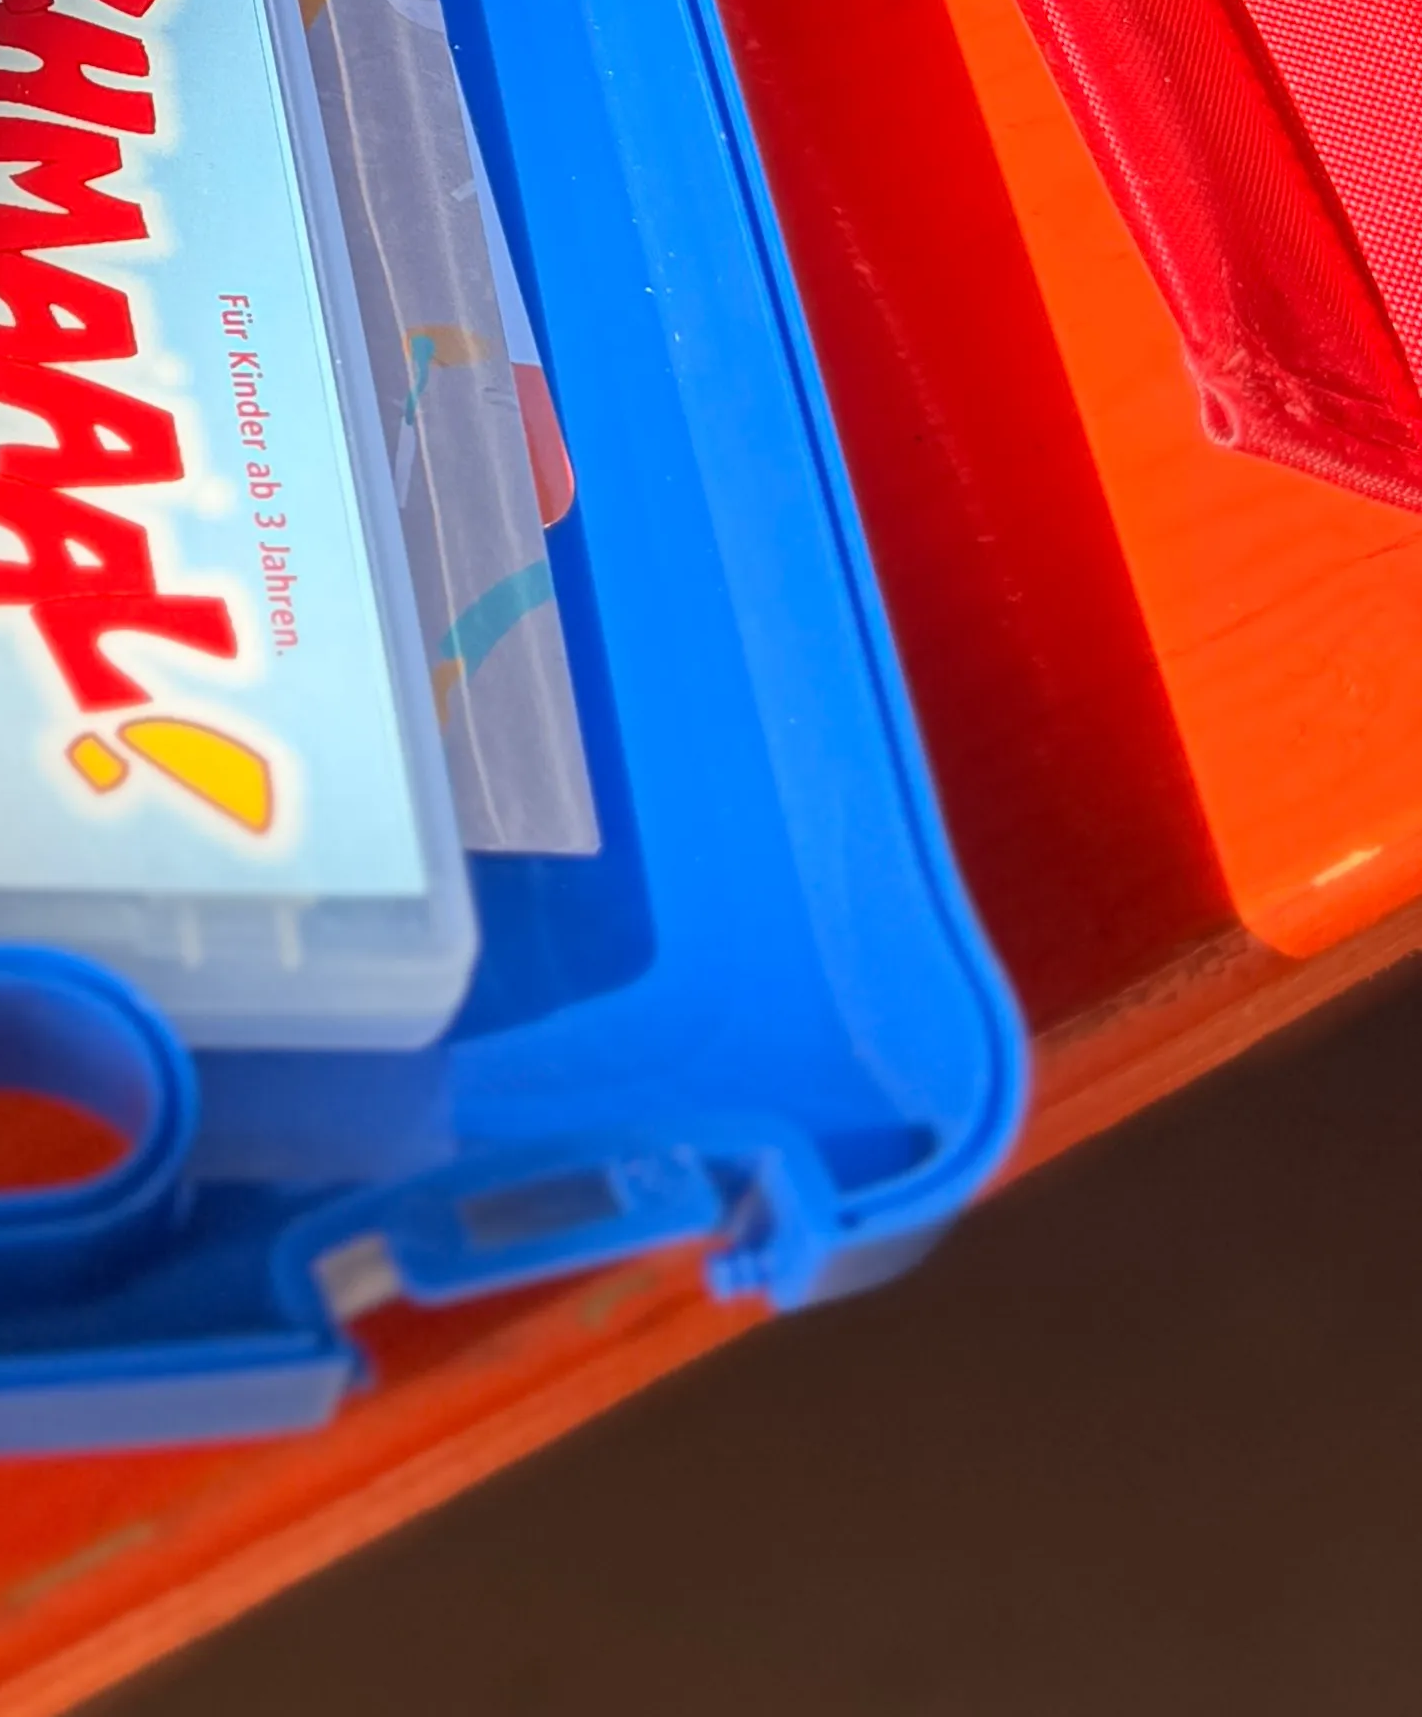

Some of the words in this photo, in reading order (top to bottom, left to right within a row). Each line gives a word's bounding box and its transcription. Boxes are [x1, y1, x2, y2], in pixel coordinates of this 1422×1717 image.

[217, 294, 254, 340] Für
[227, 351, 271, 451] Kinder
[246, 462, 283, 500] ab
[254, 512, 286, 530] 3
[259, 541, 299, 656] Jahren.
